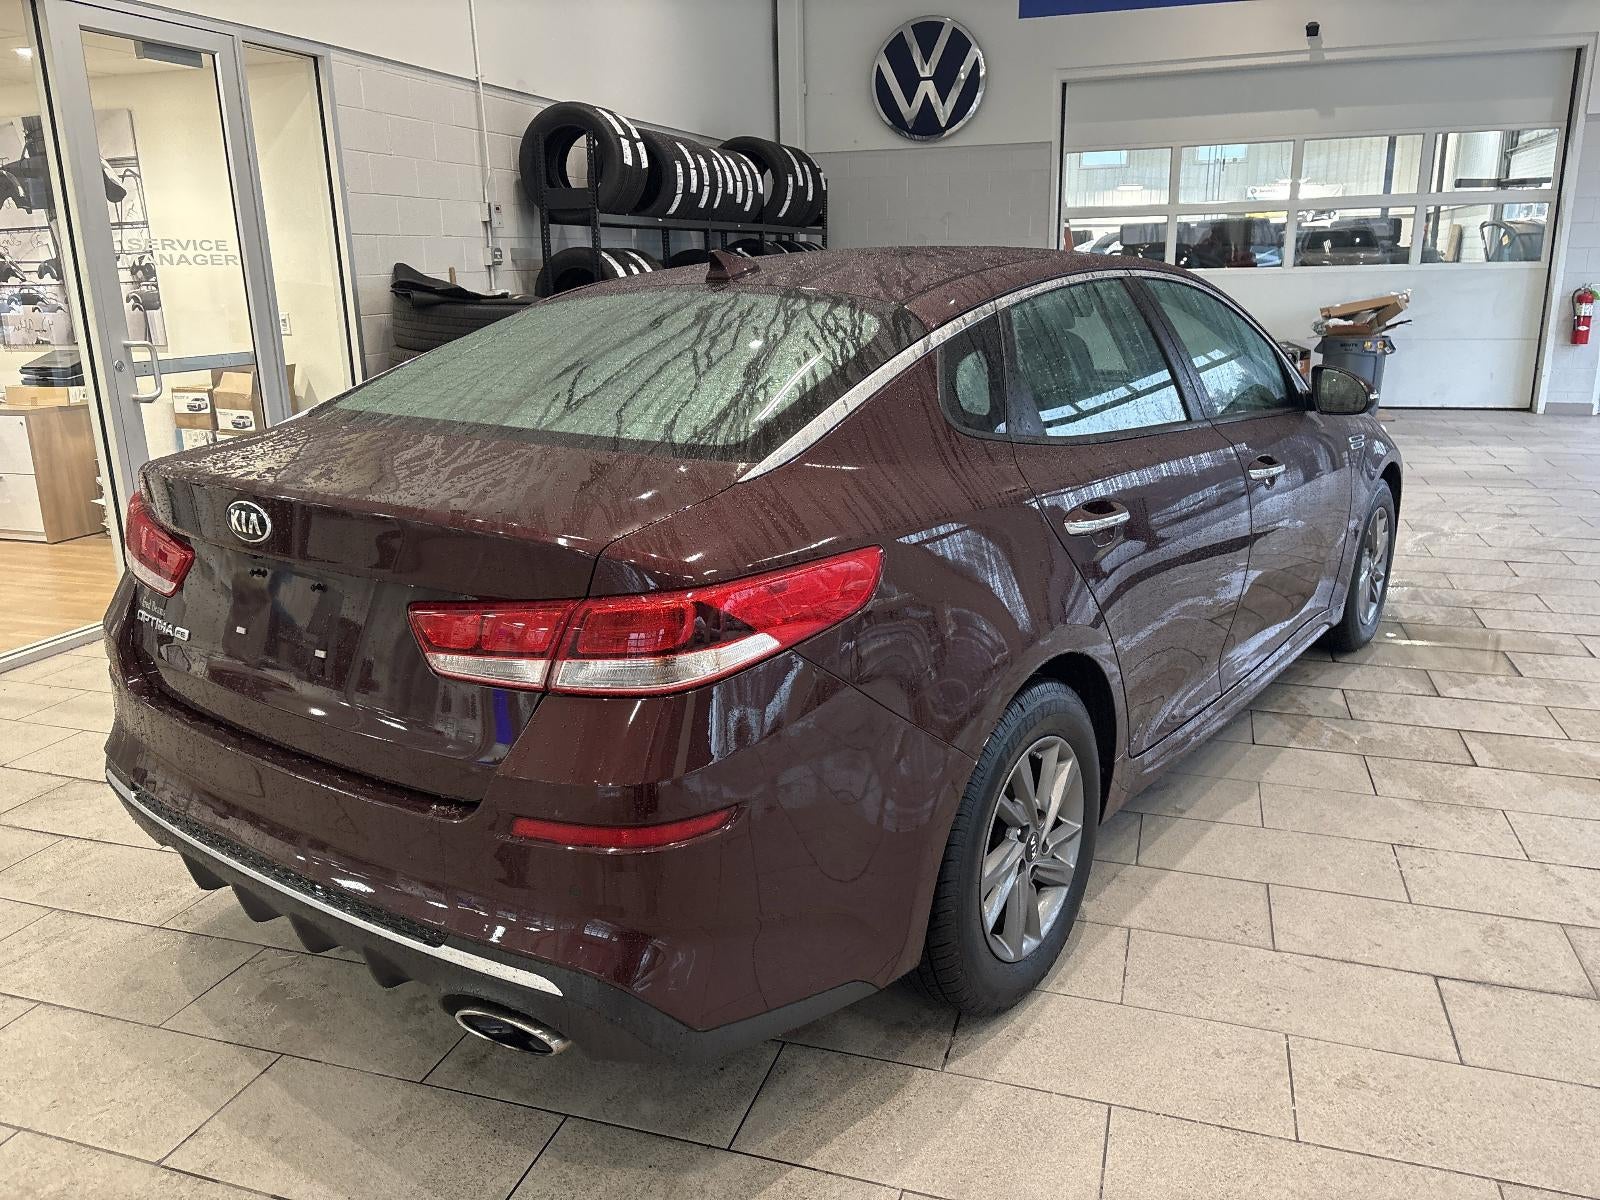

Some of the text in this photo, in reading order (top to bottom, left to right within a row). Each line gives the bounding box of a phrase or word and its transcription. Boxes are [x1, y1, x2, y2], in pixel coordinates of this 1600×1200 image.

[877, 20, 980, 130] VW
[127, 238, 229, 252] SERVICE
[121, 253, 239, 266] MANAGER
[230, 508, 262, 536] KIA
[137, 609, 175, 637] OPTIMA
